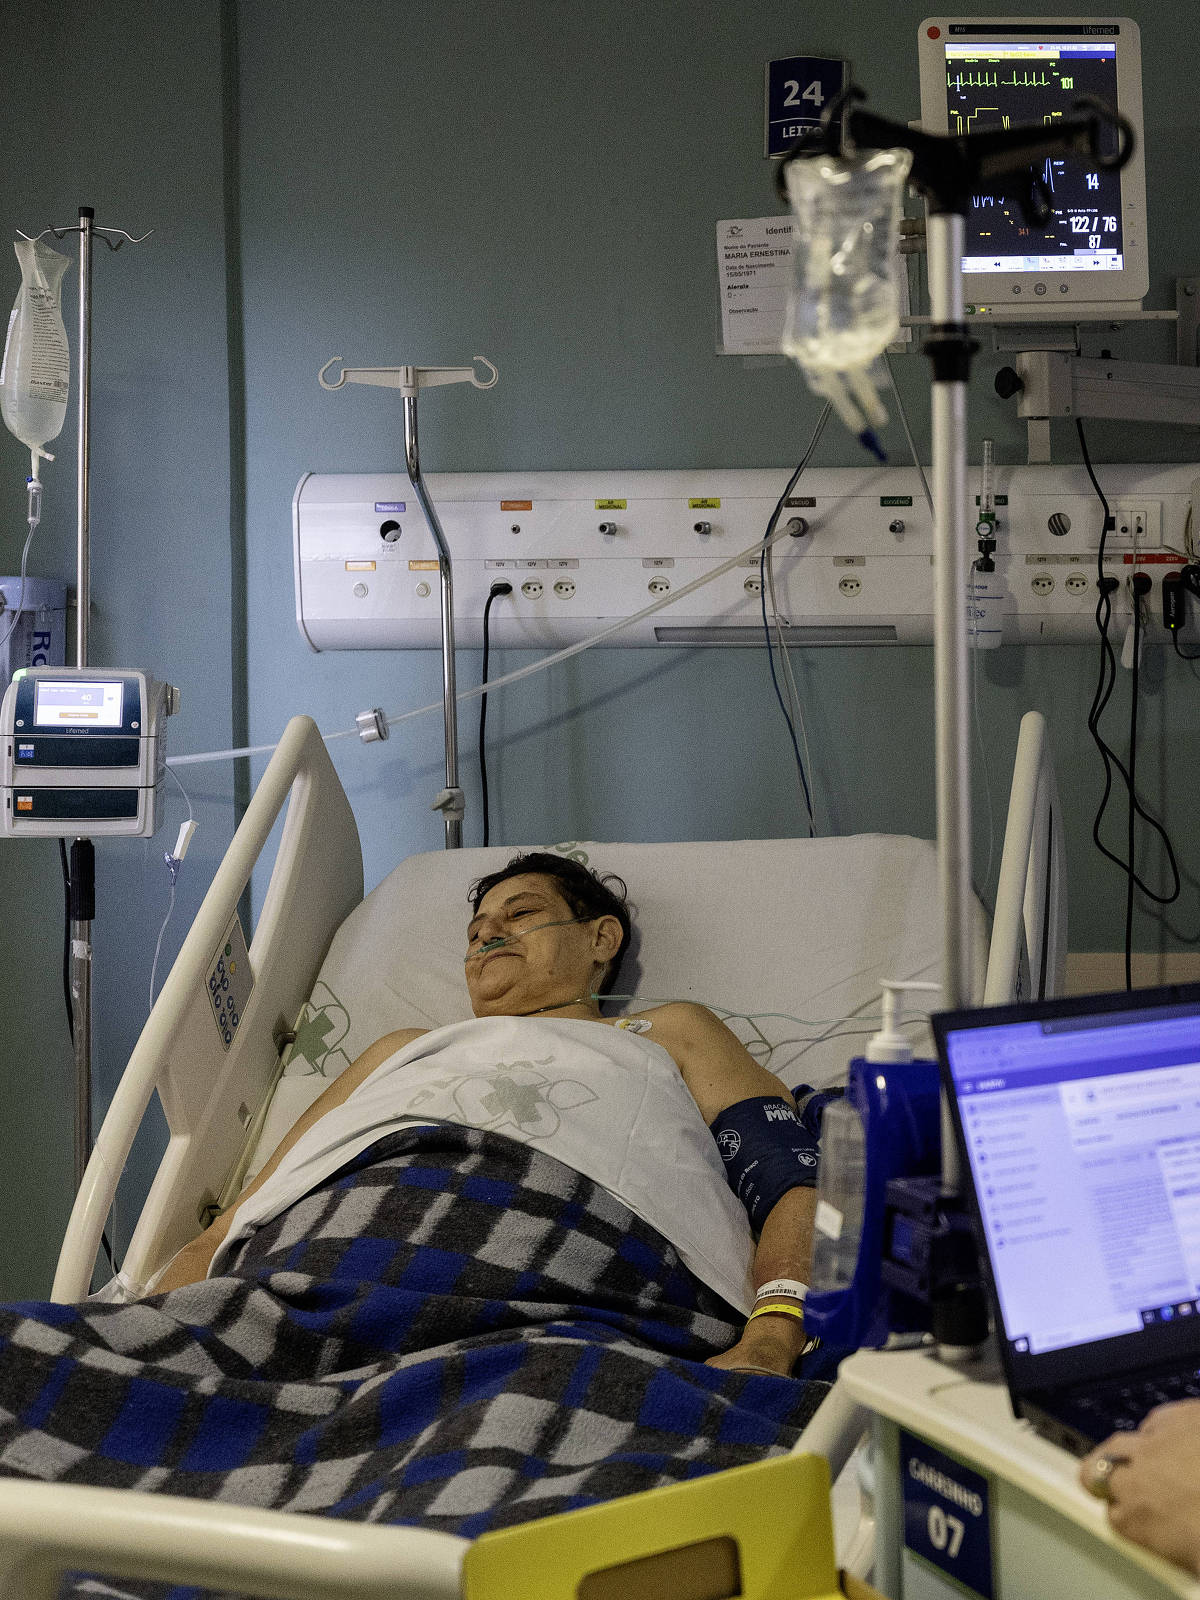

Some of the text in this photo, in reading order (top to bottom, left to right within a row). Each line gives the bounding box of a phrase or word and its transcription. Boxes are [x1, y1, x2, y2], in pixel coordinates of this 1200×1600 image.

[1060, 77, 1074, 90] 101
[783, 79, 825, 107] 24
[1086, 173, 1100, 190] 14
[1069, 216, 1090, 233] 122
[1102, 216, 1117, 232] 76
[1089, 234, 1101, 249] 87
[725, 249, 791, 260] MARIA ERNESTINA
[927, 1504, 965, 1559] 07
